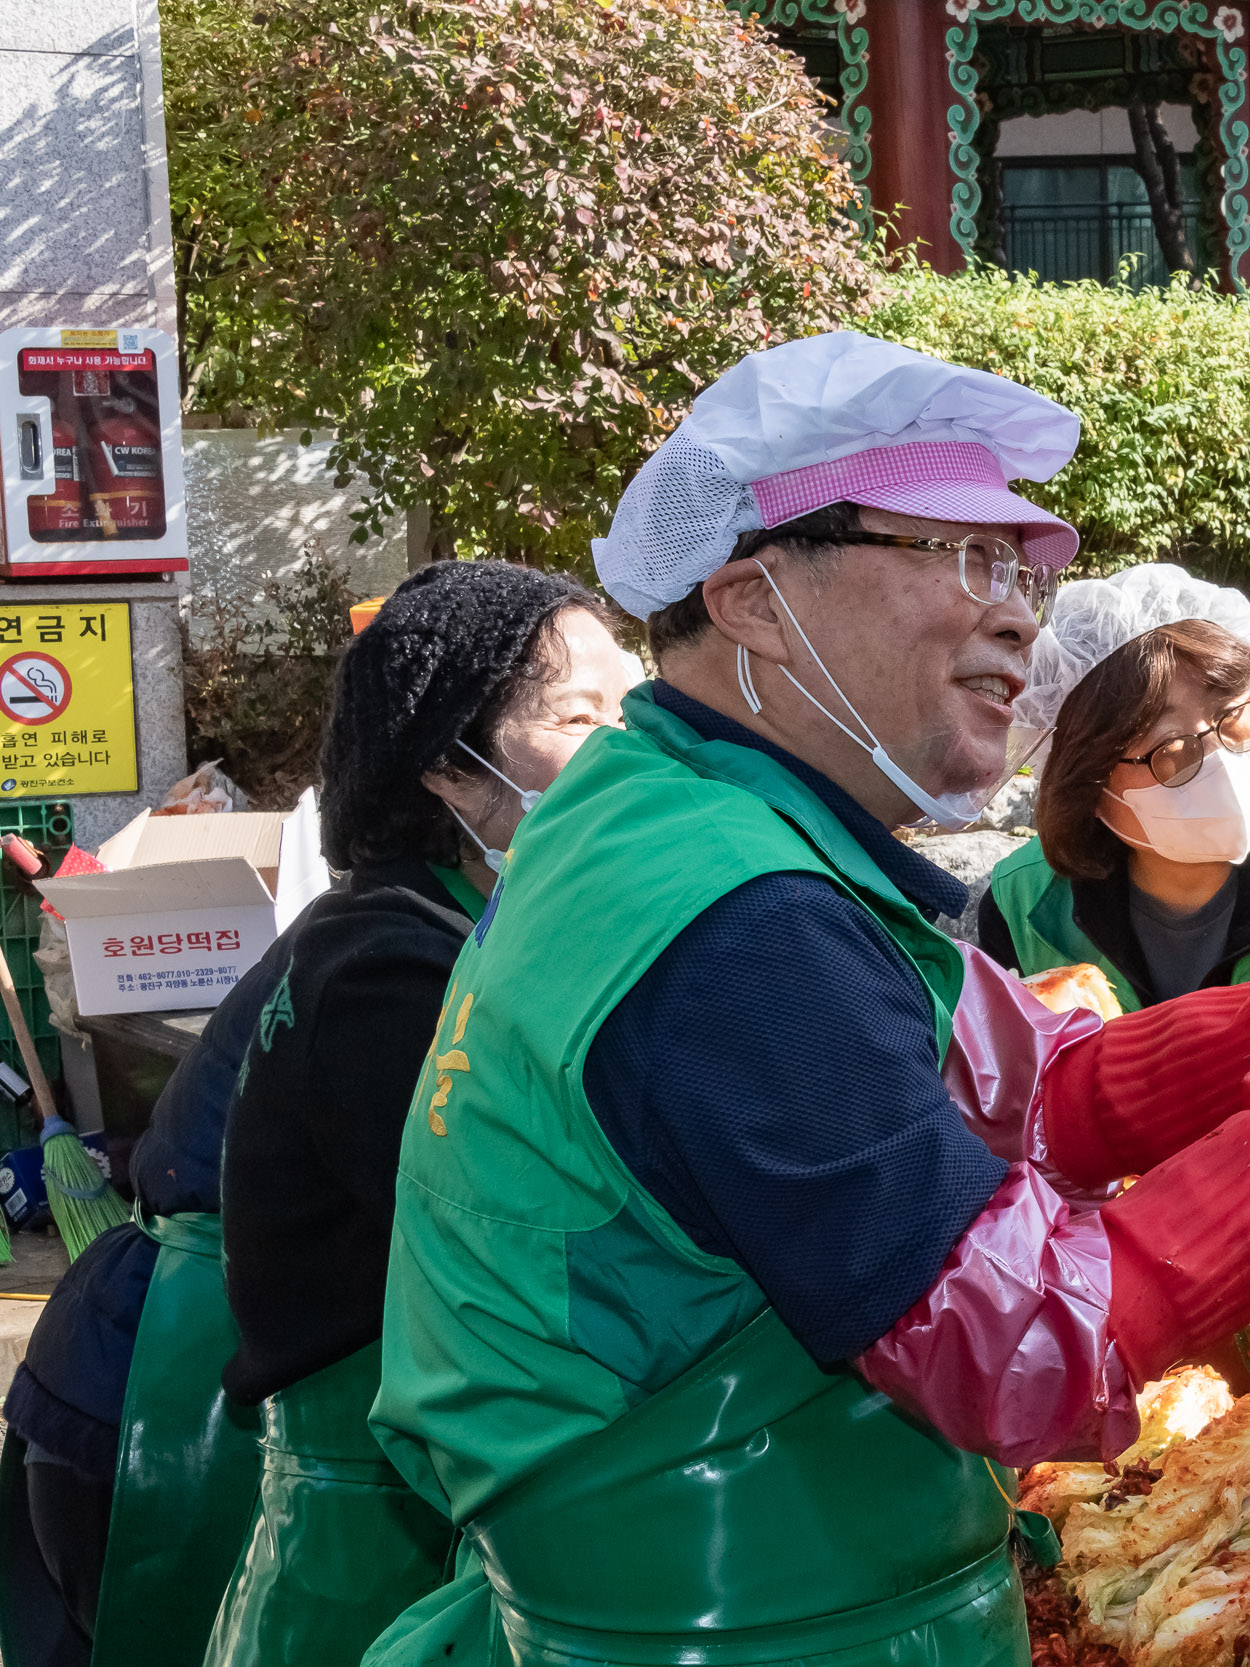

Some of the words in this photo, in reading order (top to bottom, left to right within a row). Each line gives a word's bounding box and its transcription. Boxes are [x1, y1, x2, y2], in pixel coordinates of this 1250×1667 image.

[28, 356, 54, 365] 화재시
[57, 356, 82, 365] 누구나
[85, 356, 101, 365] 사용
[114, 446, 129, 455] CW
[58, 519, 79, 528] Fire
[51, 729, 108, 746] 피해로
[2, 753, 36, 769] 받고
[43, 750, 111, 768] 있습니다
[102, 929, 241, 958] 호원당떡집
[140, 981, 163, 991] 광진구
